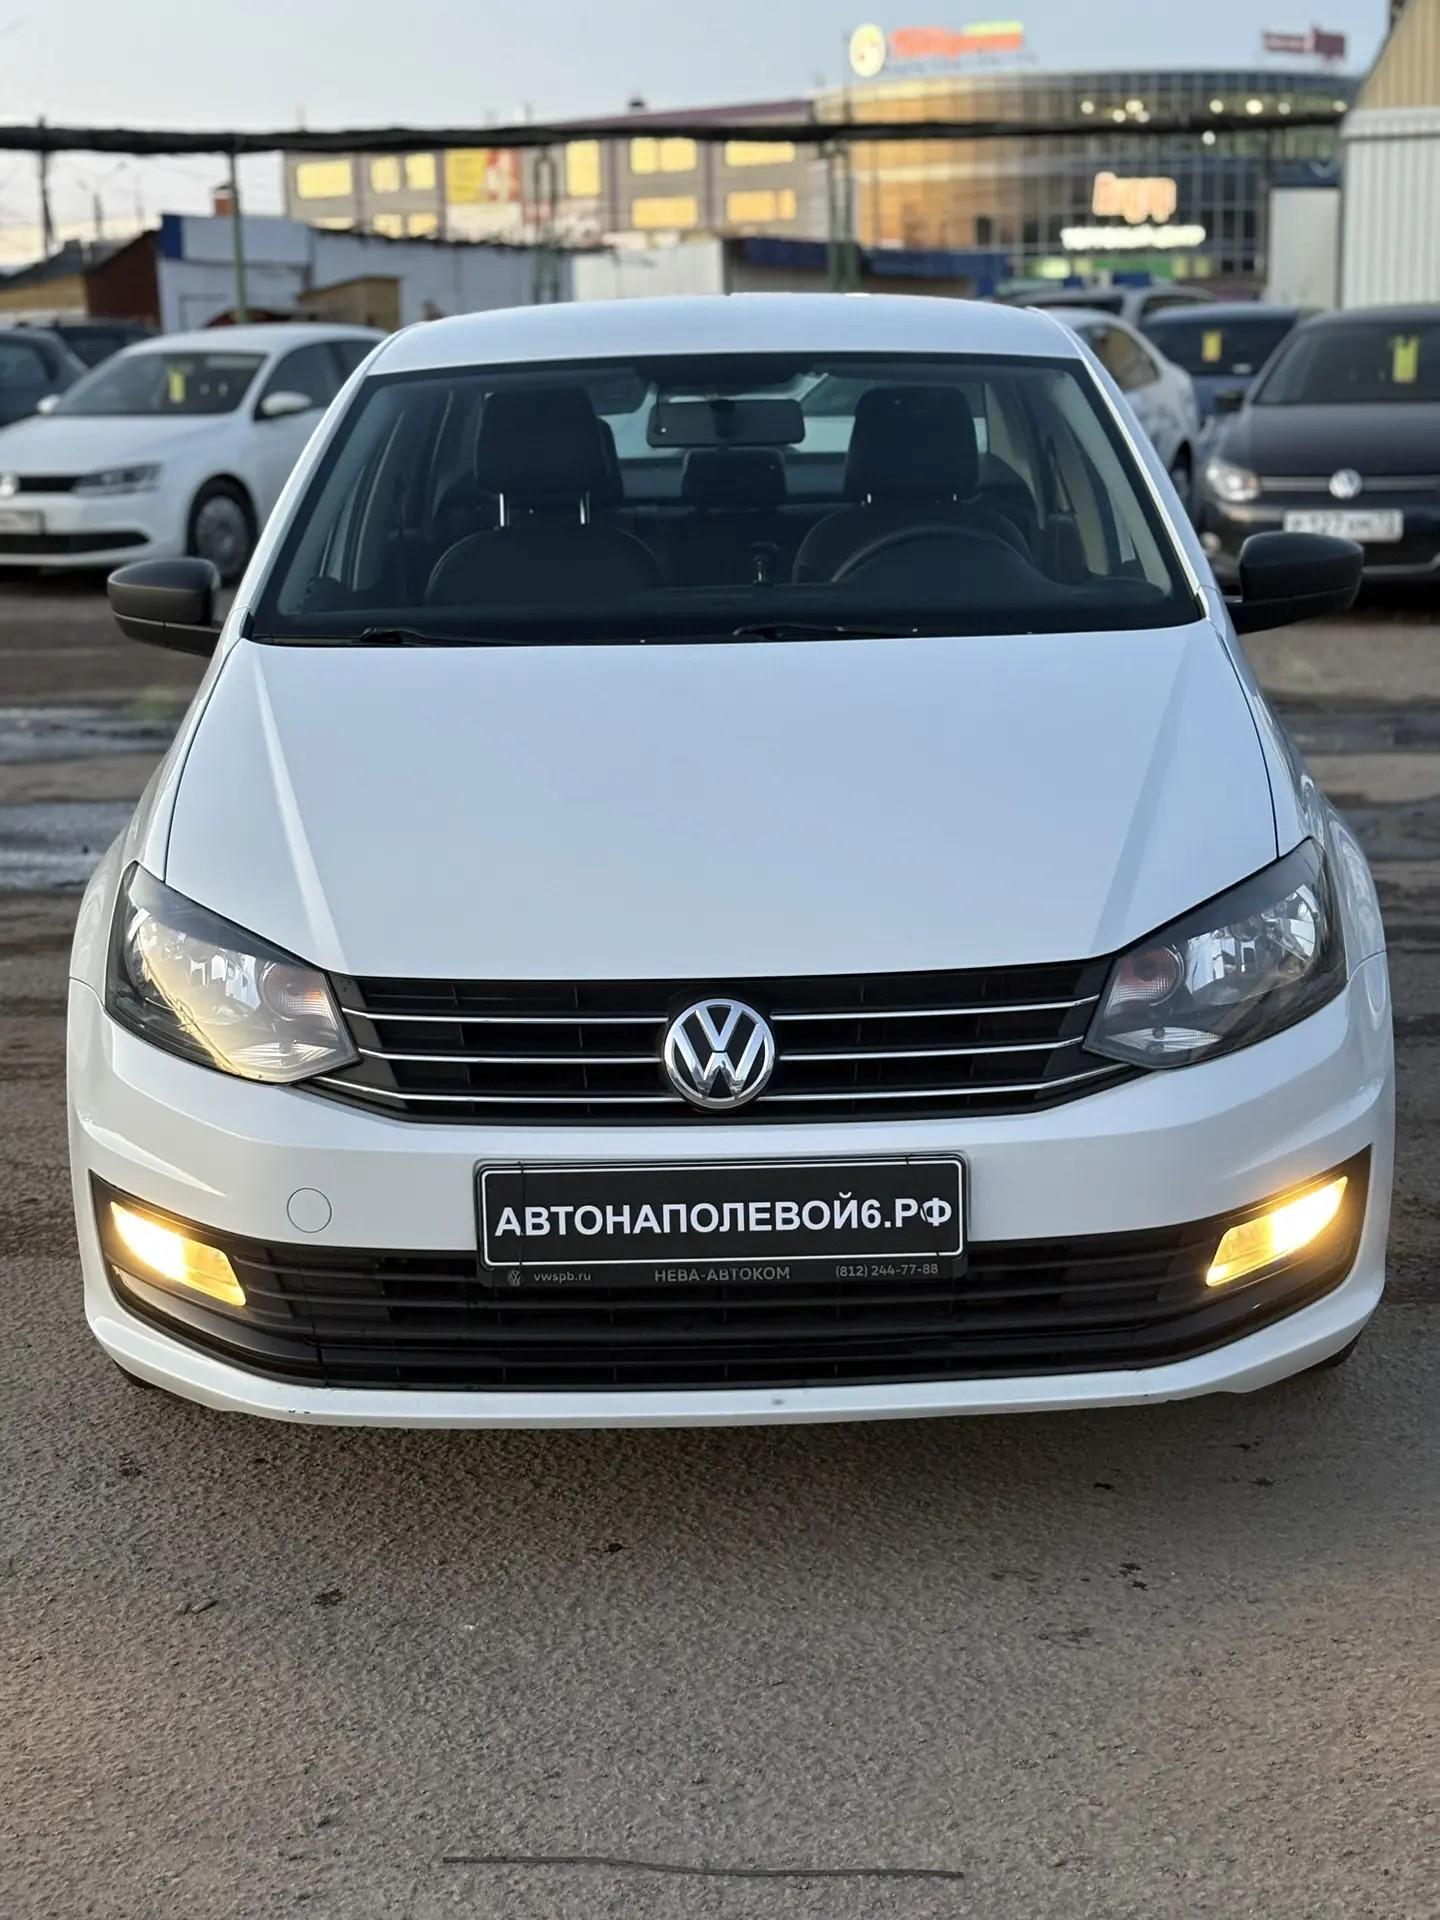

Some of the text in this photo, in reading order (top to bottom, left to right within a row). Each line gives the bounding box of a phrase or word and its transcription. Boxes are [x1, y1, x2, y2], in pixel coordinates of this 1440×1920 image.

[495, 1191, 952, 1237] АВТОНАПОЛЕВОЙ6.РФ
[533, 1270, 592, 1284] vwspb.ru
[654, 1266, 791, 1283] НЕВА-АВТОКОМ
[835, 1263, 939, 1279] (812) 244-77-88
